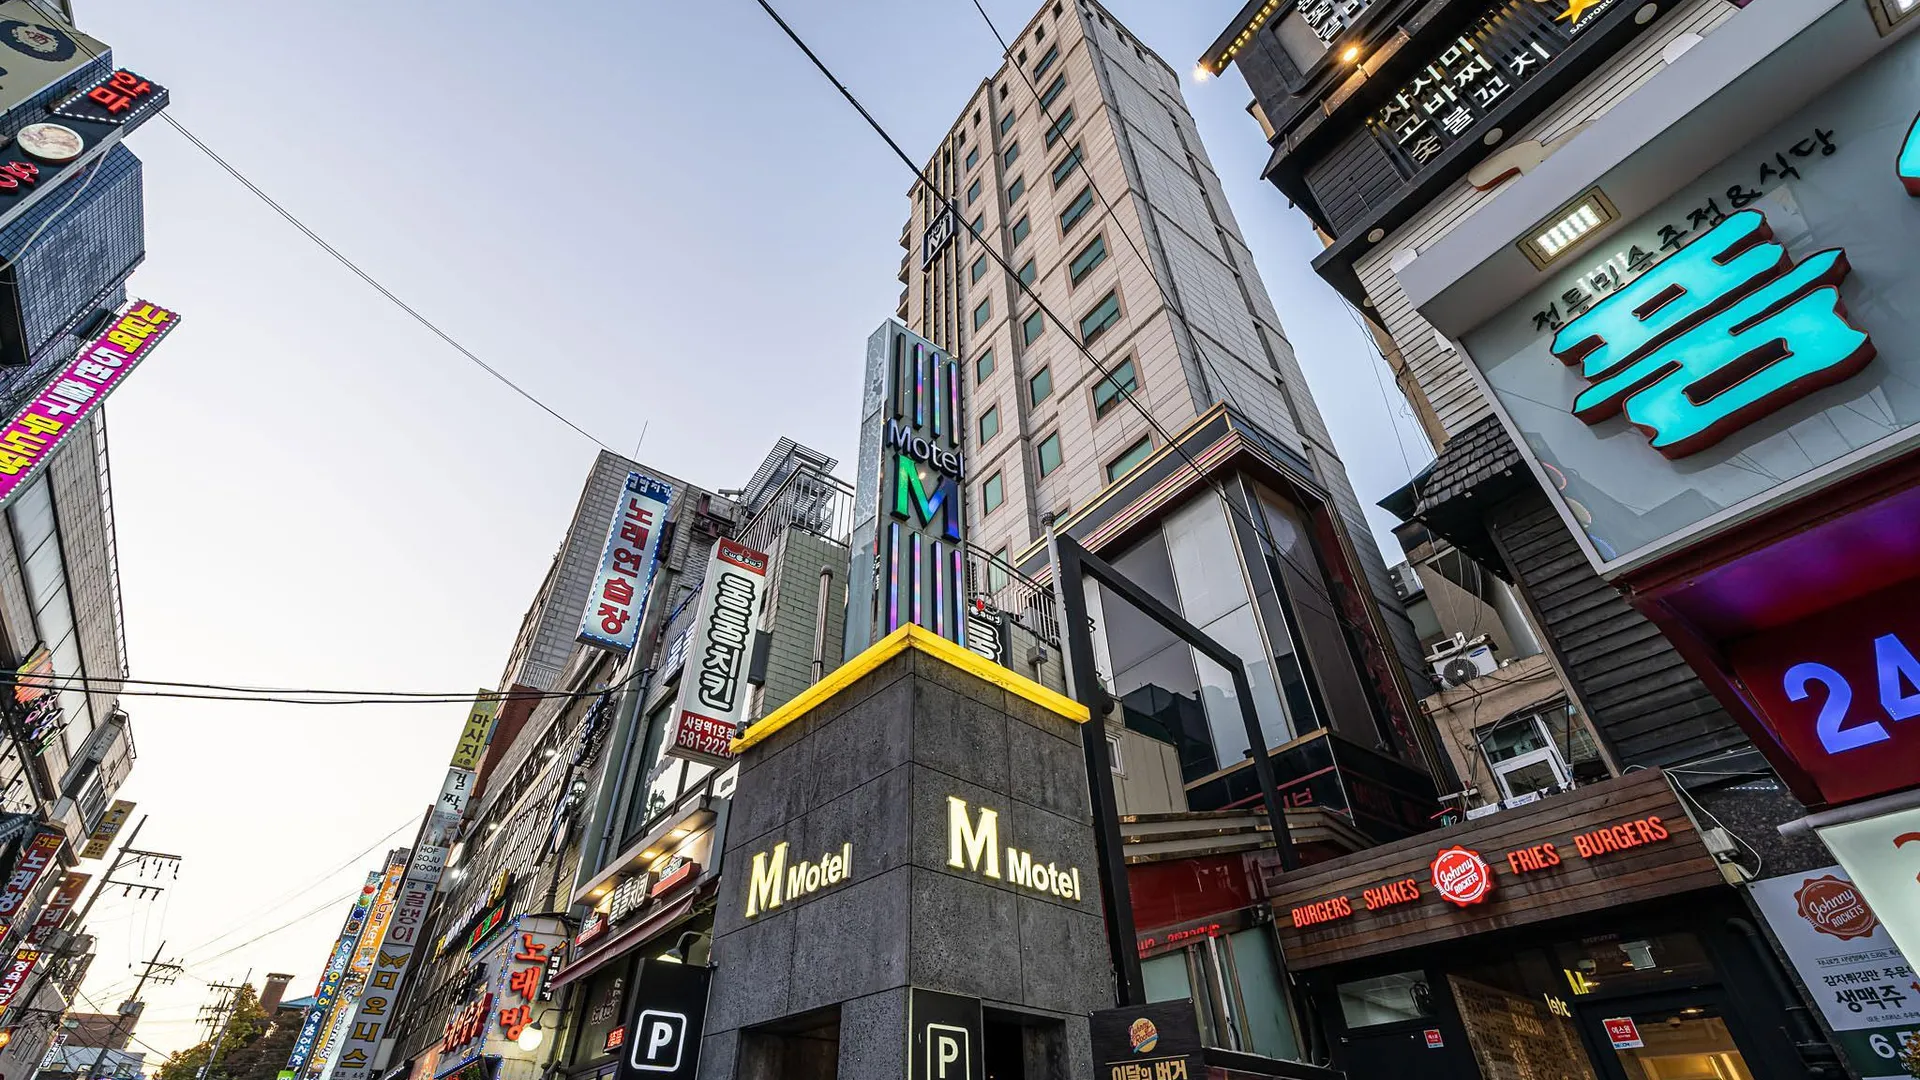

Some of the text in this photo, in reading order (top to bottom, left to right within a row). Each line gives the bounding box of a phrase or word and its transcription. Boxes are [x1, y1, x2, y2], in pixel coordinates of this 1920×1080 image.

[1383, 36, 1475, 123] 사시미
[1395, 55, 1493, 146] 고바찌
[886, 417, 965, 481] Motel
[890, 453, 962, 544] M
[597, 498, 653, 635] 노래연습장
[460, 713, 489, 758] 마사지
[417, 855, 441, 864] SOJU
[420, 846, 439, 854] HOF
[946, 795, 1000, 879] M
[1506, 815, 1669, 875] FRIES BURGERS
[0, 849, 46, 912] 노래방
[413, 863, 441, 874] ROOM
[744, 841, 790, 918] M
[786, 842, 854, 900] Motel
[1005, 847, 1081, 901] Motel
[1439, 858, 1475, 891] Johnny
[1453, 872, 1479, 894] ROCKETS
[392, 890, 427, 943] 골뱅이
[1290, 878, 1421, 930] BURGERS SHAKES
[1809, 889, 1857, 924] Johnny
[1831, 904, 1864, 928] ROCKETS
[499, 933, 548, 1041] 노래방
[1822, 969, 1880, 987] 감자튀김만
[1835, 985, 1907, 1013] 생맥주
[340, 971, 400, 1069] 디오니스
[646, 1021, 674, 1060] P
[938, 1035, 960, 1079] P
